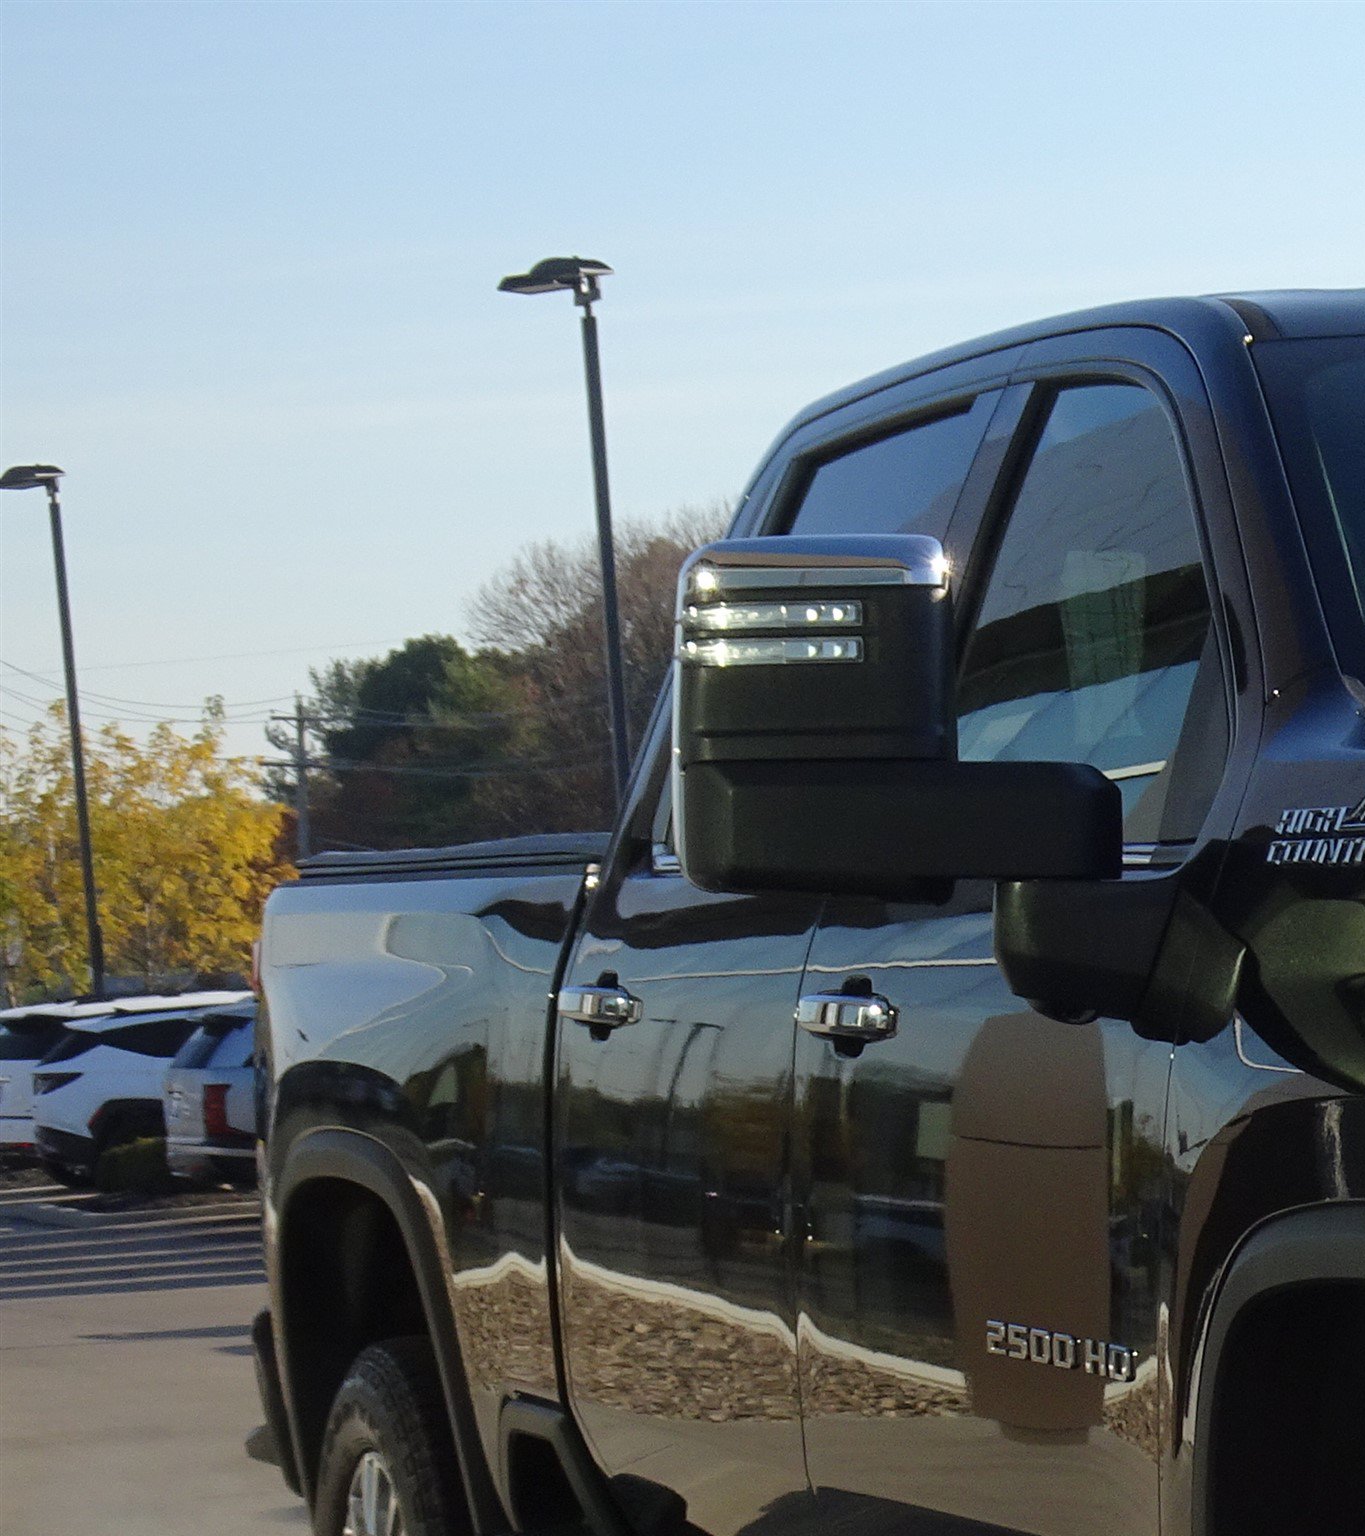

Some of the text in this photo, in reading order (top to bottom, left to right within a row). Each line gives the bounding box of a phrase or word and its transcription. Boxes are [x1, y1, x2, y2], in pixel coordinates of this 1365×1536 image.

[1274, 806, 1350, 835] HIGH
[985, 1319, 1131, 1382] 2500 HD
